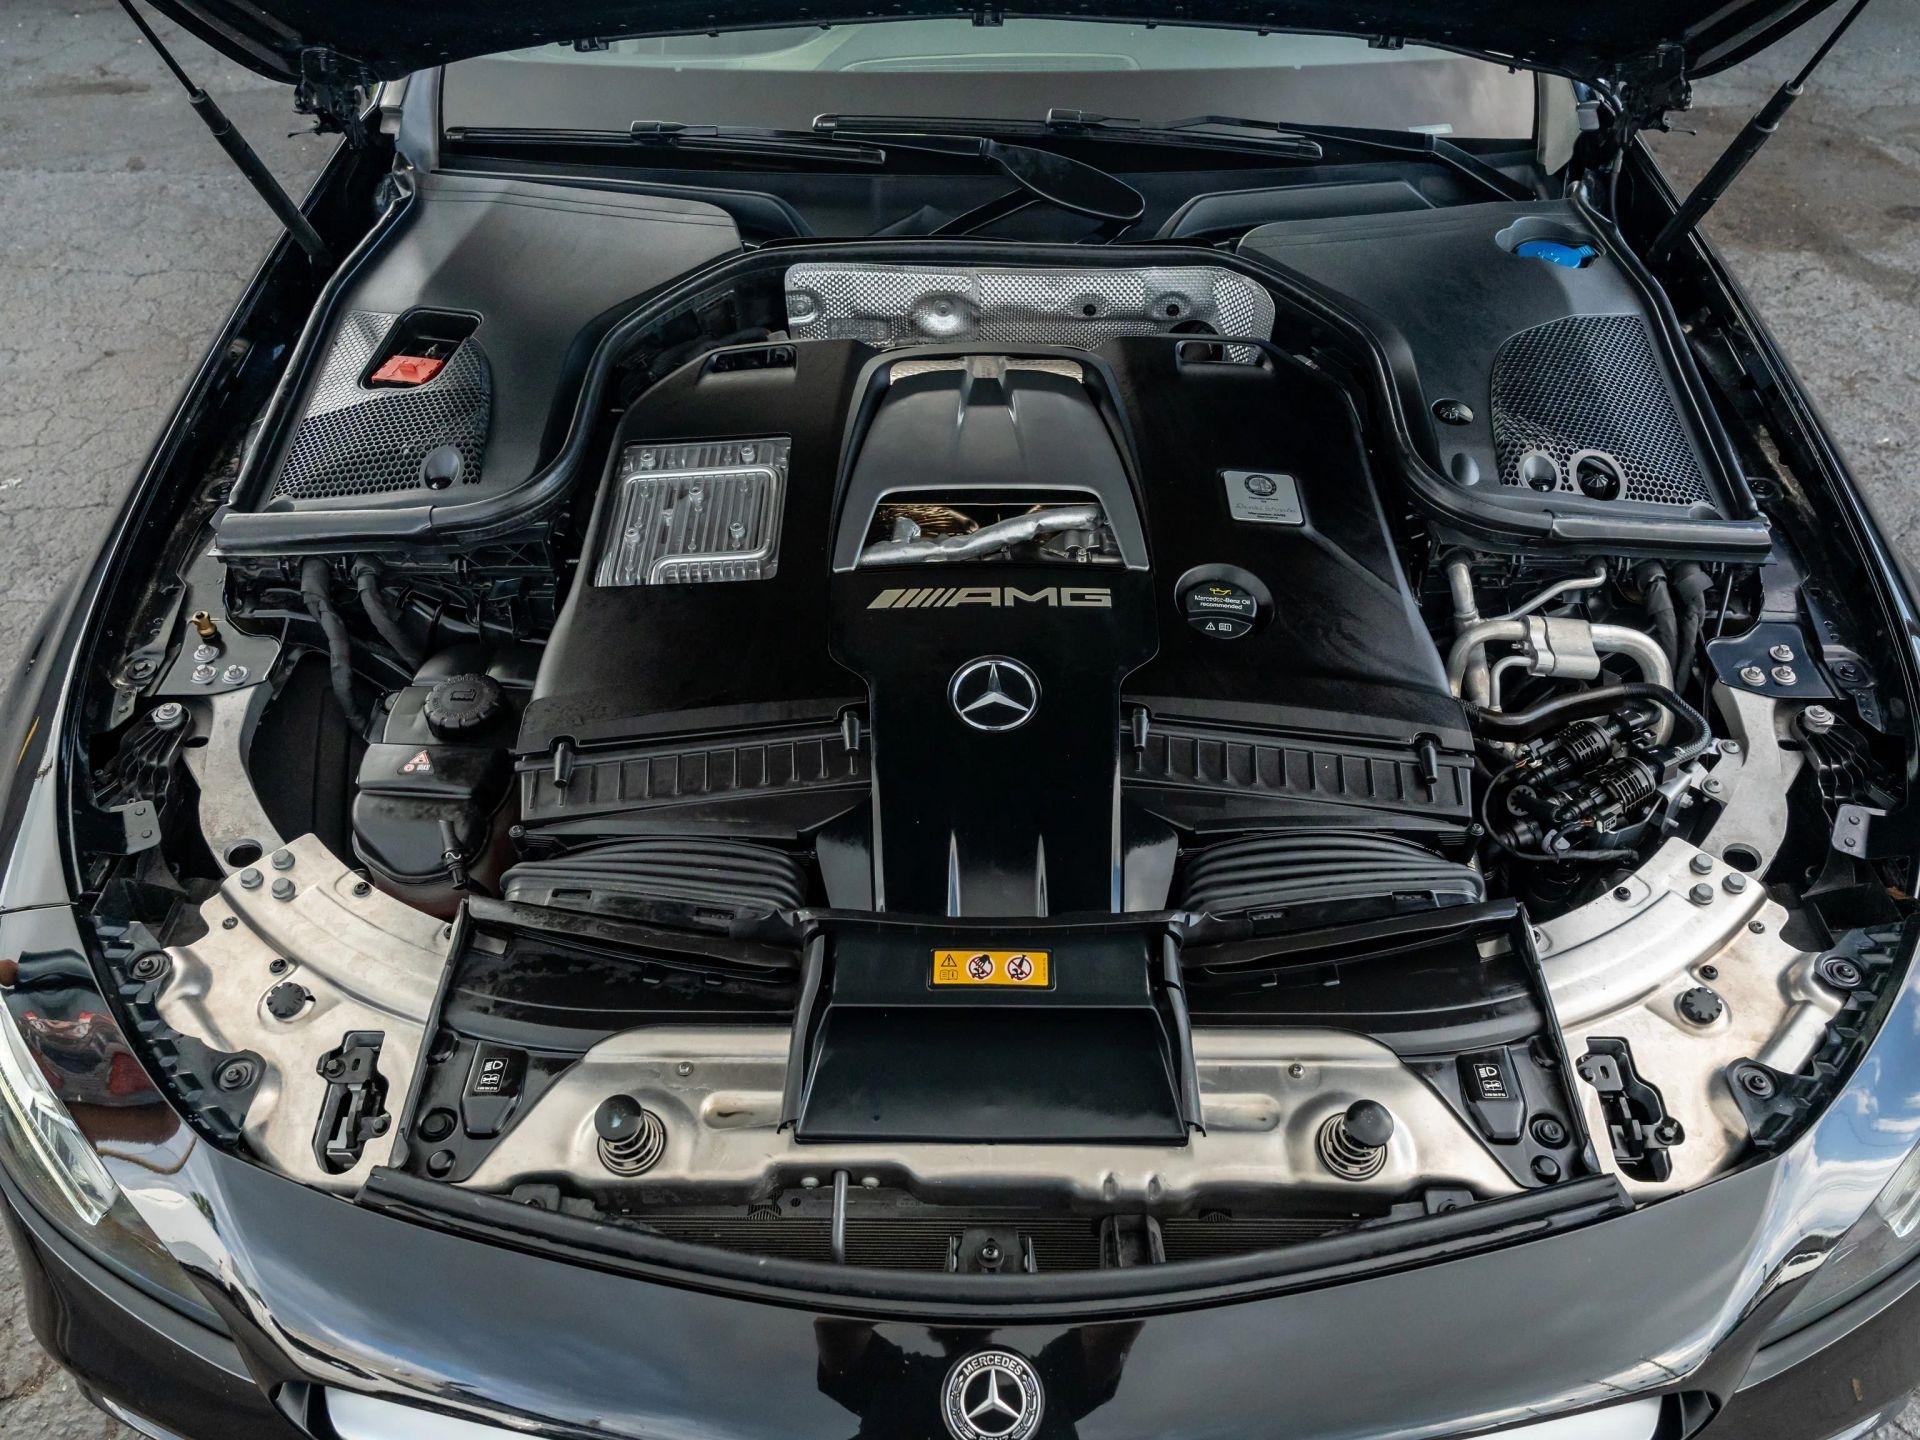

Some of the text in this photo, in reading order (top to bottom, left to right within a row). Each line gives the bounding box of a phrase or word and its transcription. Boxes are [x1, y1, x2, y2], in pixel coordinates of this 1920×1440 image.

[944, 587, 1113, 608] AMG
[1200, 602, 1243, 610] recommended
[962, 1355, 1023, 1376] MERCEDES
